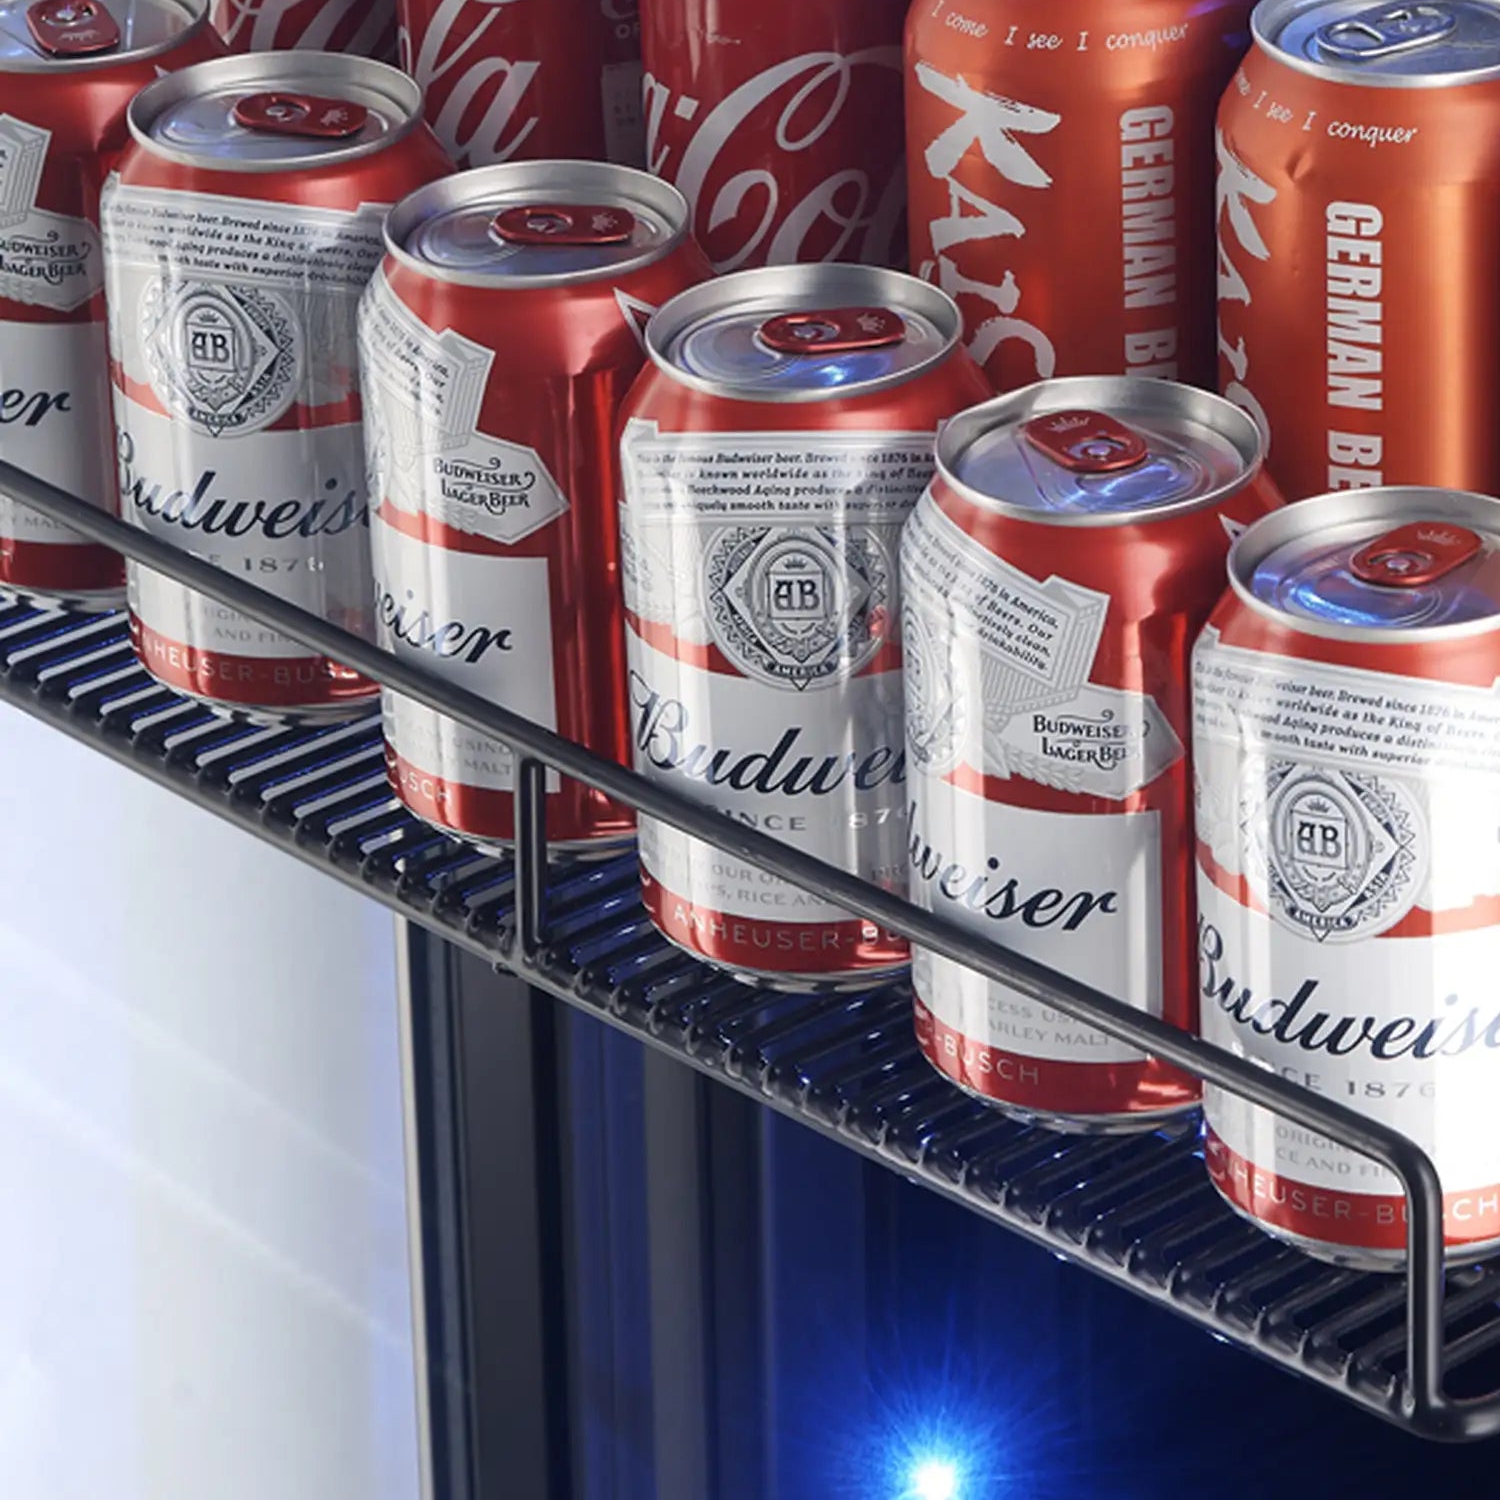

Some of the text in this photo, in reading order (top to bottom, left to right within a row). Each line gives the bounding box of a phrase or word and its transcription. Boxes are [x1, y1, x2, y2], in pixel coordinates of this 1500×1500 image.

[945, 11, 1189, 52] come I see I conquer
[1253, 91, 1418, 148] I see I conquer
[1118, 105, 1177, 309] GERMAN
[0, 240, 79, 258] UDWEISER
[191, 331, 231, 364] AB
[1325, 200, 1383, 493] GERMAN BE
[117, 430, 369, 539] Budweis
[434, 458, 522, 486] BUDWEISER
[742, 466, 809, 479] worldwide
[442, 479, 531, 514] LAGER BEER
[774, 579, 820, 612] AB
[375, 581, 513, 664] eiser
[1337, 689, 1418, 713] Brewed since
[630, 670, 906, 796] Budwei
[1320, 723, 1381, 742] produces
[1363, 712, 1386, 726] the
[1389, 716, 1422, 733] King
[1042, 738, 1098, 763] LAGER
[1372, 750, 1431, 765] superior
[1297, 819, 1342, 860] AB
[907, 801, 1118, 931] weiser
[737, 888, 789, 906] RICE
[672, 902, 905, 951] ANHEUSER-B
[1346, 1078, 1436, 1099] 1876
[1306, 1155, 1351, 1177] AND
